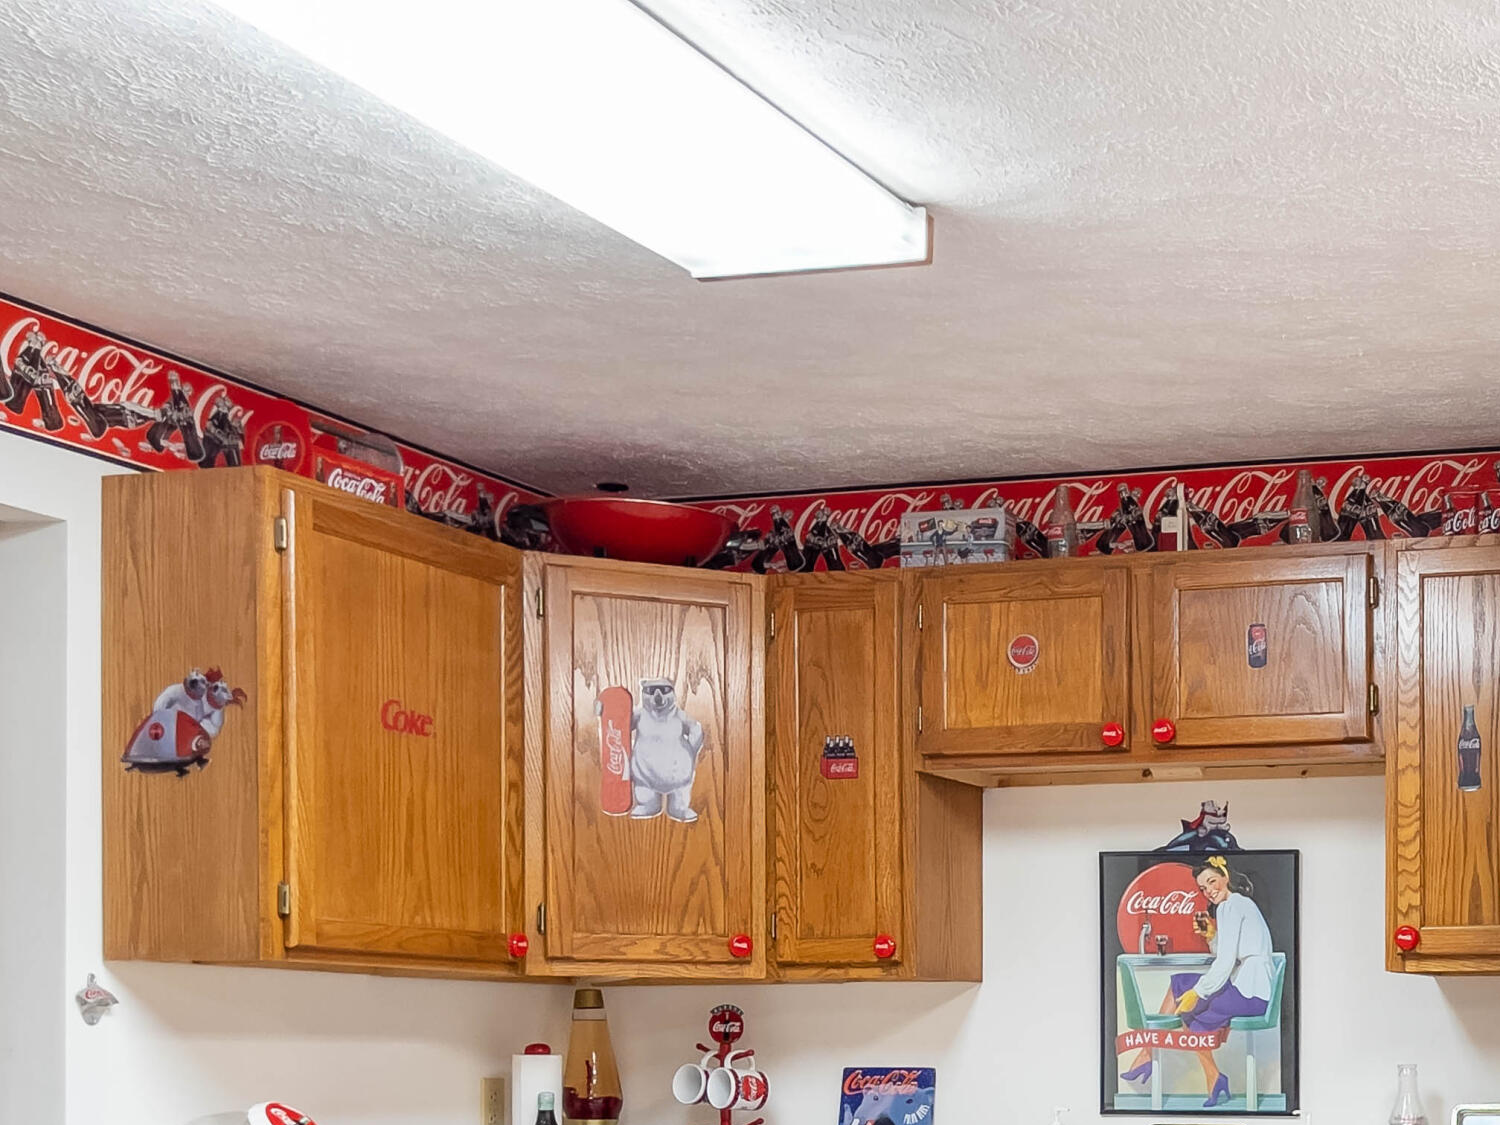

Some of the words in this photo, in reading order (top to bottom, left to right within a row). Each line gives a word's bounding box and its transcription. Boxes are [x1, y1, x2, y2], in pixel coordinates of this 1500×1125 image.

[0, 317, 163, 408] Cca-Cola
[380, 699, 433, 738] Coke
[1126, 890, 1197, 915] Coca-Cola
[1125, 1033, 1159, 1047] HAVE
[1164, 1032, 1175, 1046] A
[1178, 1033, 1216, 1048] COKE
